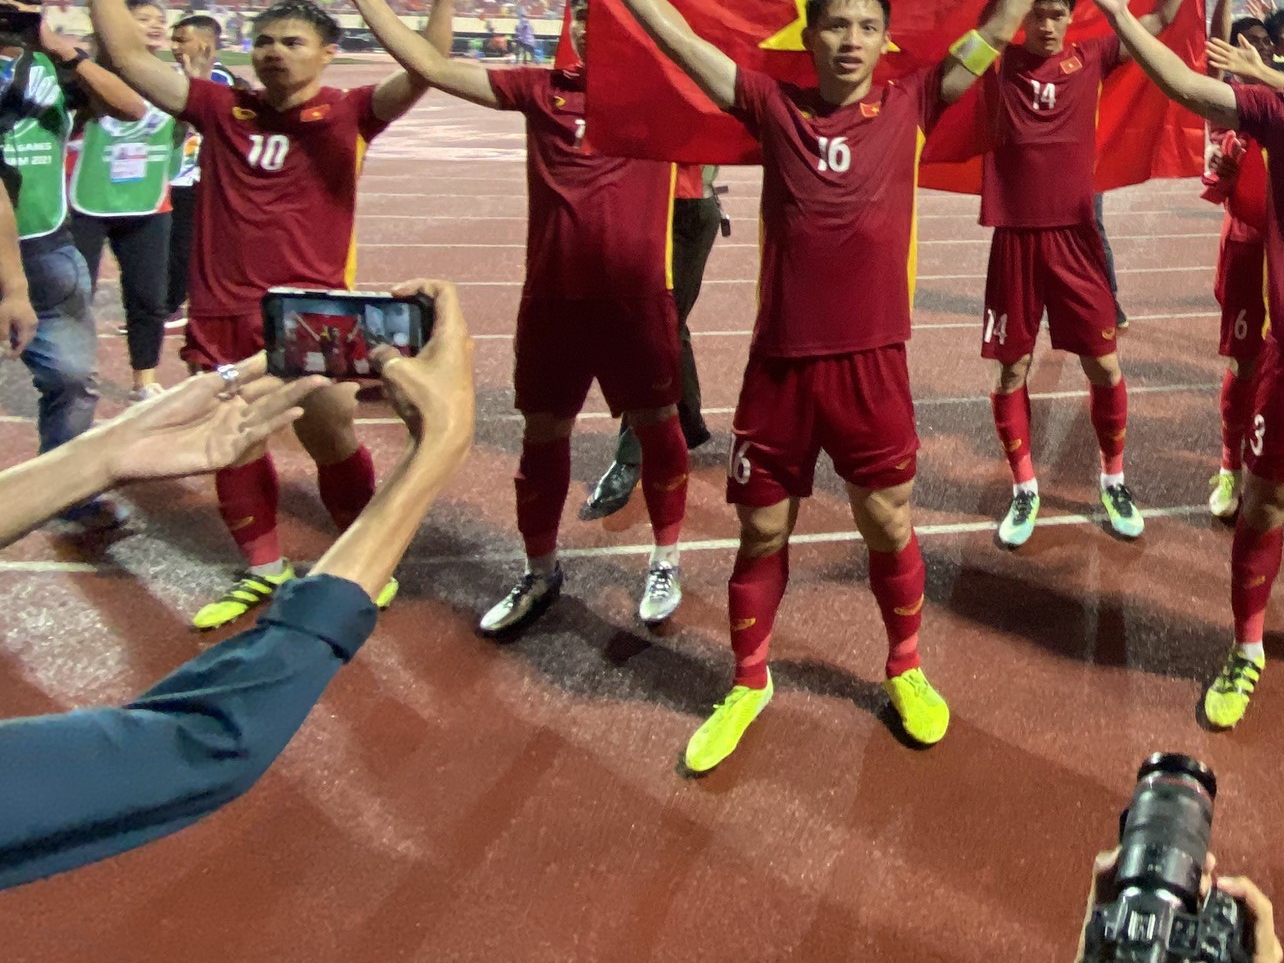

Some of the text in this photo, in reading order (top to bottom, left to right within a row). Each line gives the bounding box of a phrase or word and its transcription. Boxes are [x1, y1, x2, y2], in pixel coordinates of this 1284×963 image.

[1031, 79, 1056, 109] 14
[248, 134, 290, 170] 10
[817, 136, 851, 173] 16
[984, 308, 1008, 345] 14
[1234, 308, 1248, 340] 6
[1250, 414, 1266, 457] 3
[730, 433, 751, 485] 16
